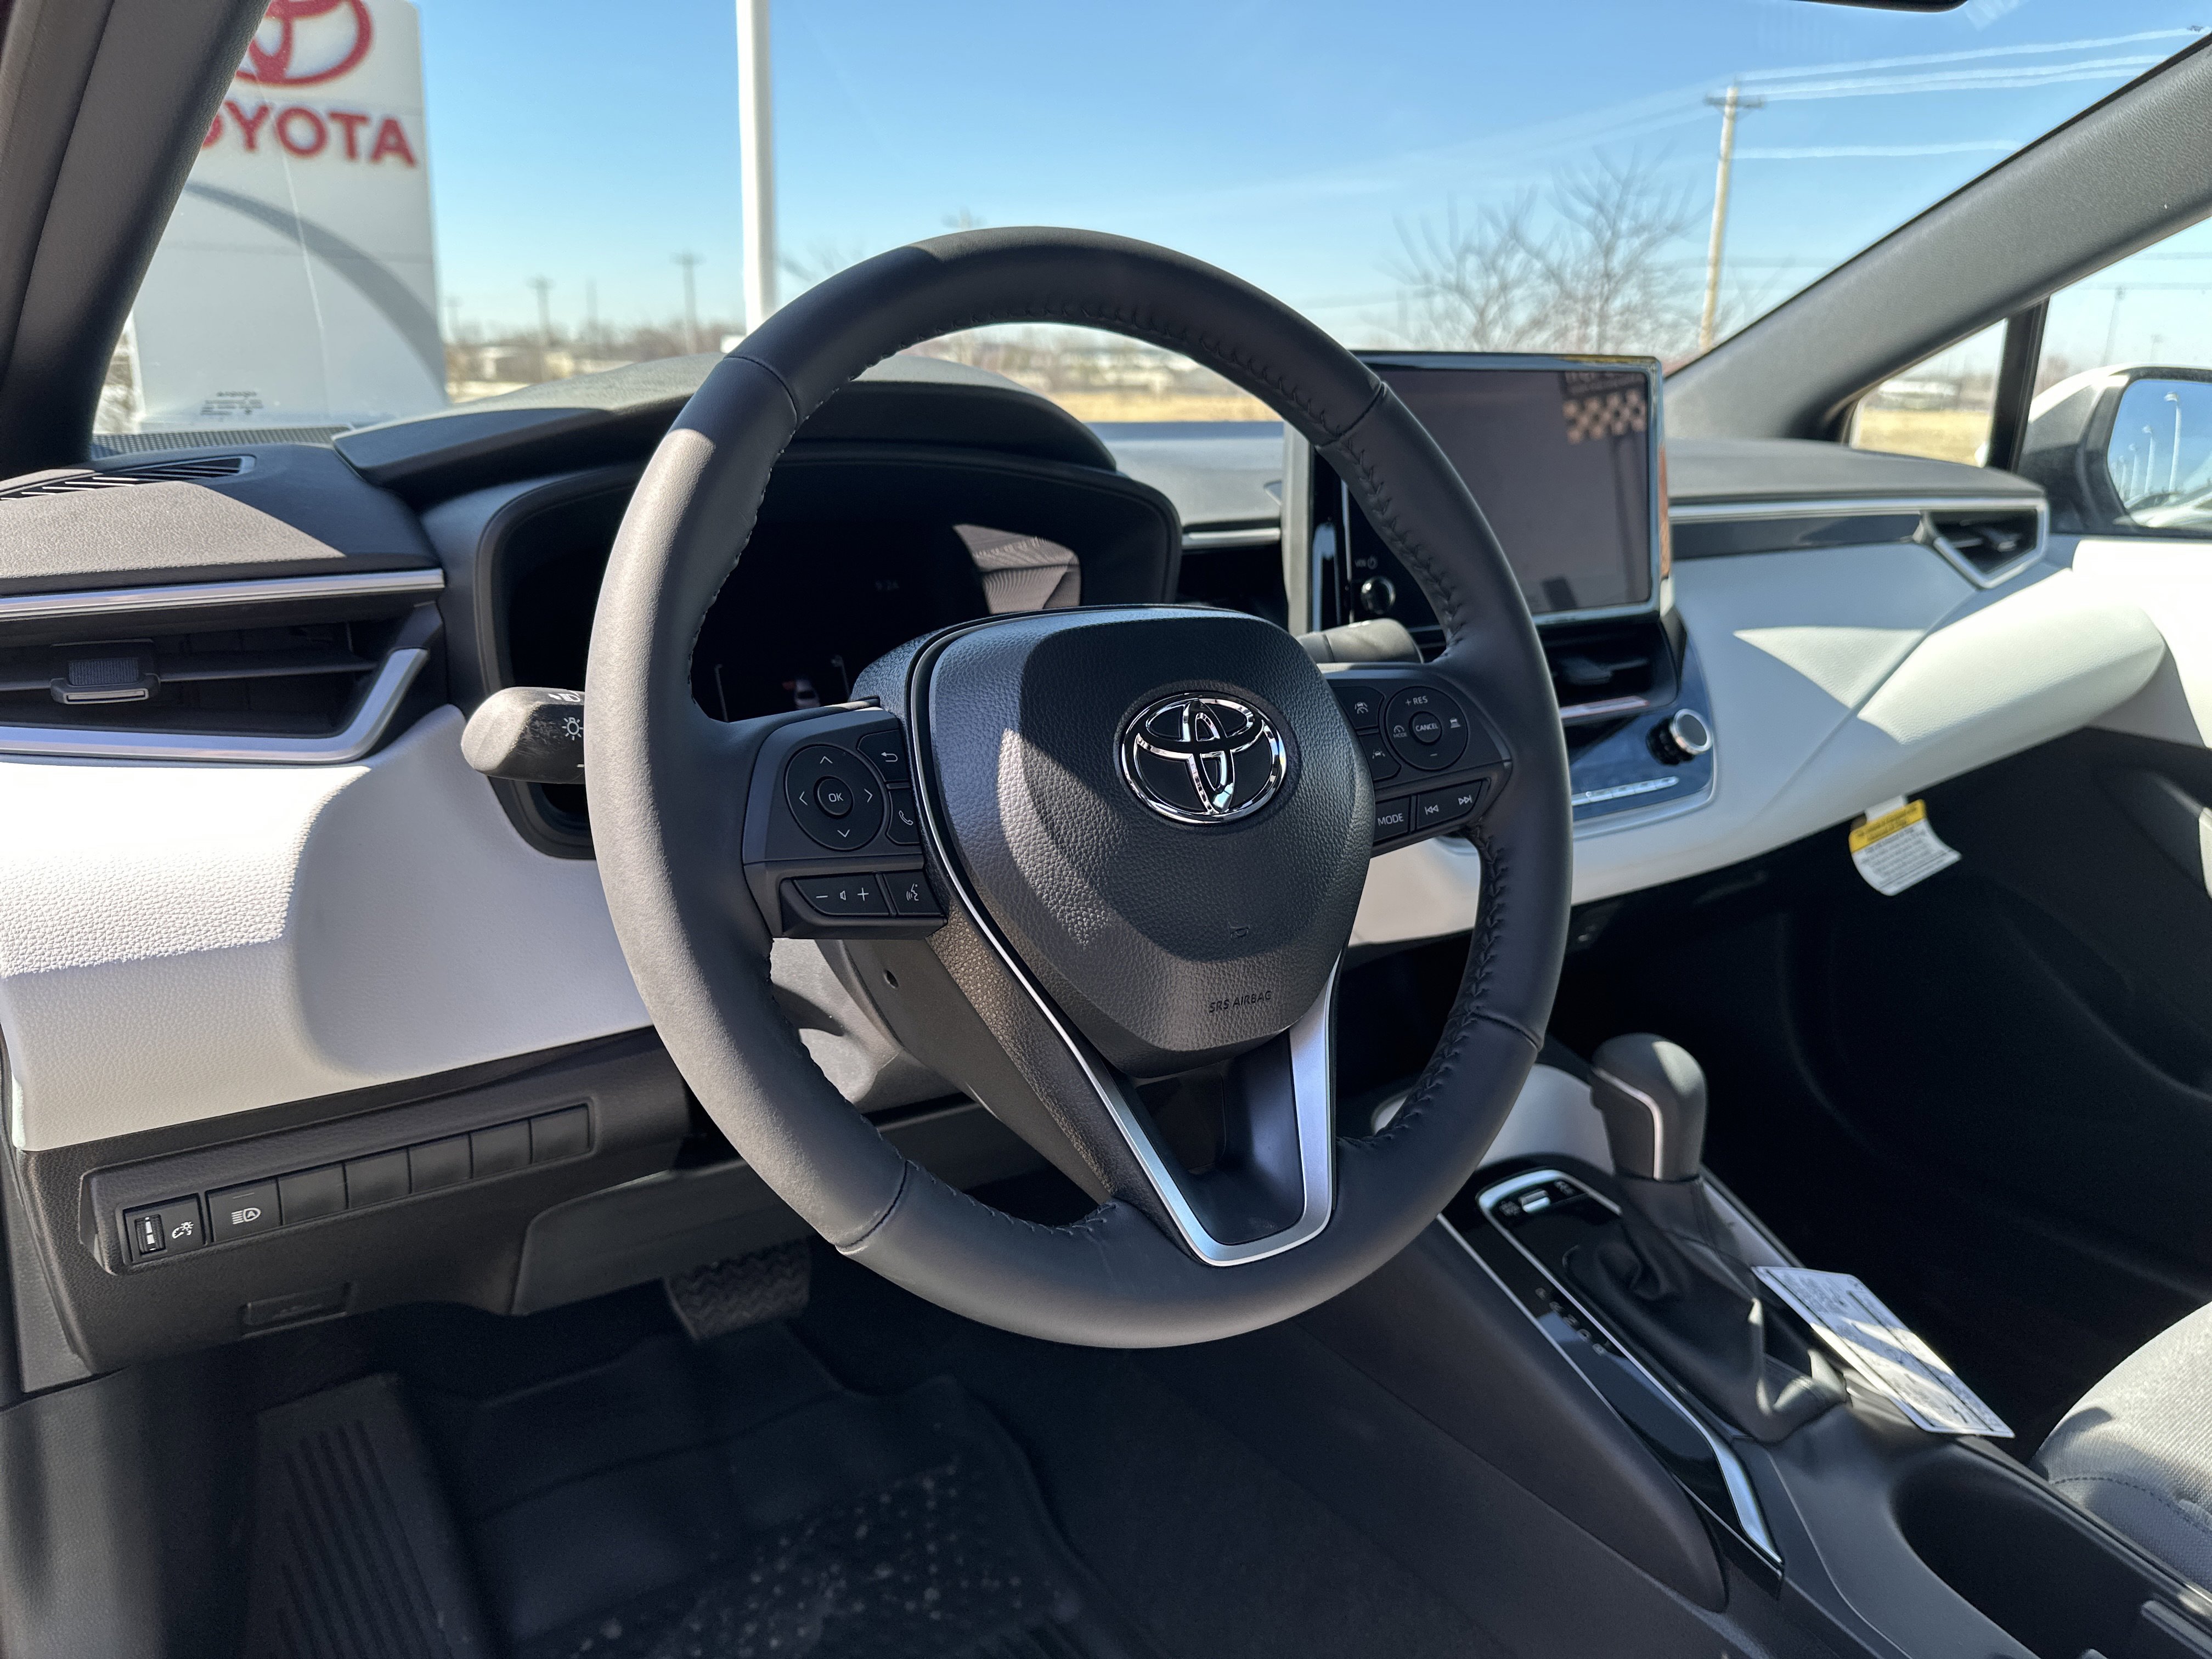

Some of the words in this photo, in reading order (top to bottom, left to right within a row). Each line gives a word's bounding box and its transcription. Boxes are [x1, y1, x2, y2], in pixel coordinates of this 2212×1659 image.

[201, 100, 416, 167] YOTA
[1413, 696, 1428, 704] RES
[1415, 723, 1438, 732] CANCEL
[828, 793, 843, 802] OK
[1378, 813, 1403, 826] MODE
[1209, 999, 1229, 1013] SRS
[1233, 991, 1271, 1007] AIRBAG
